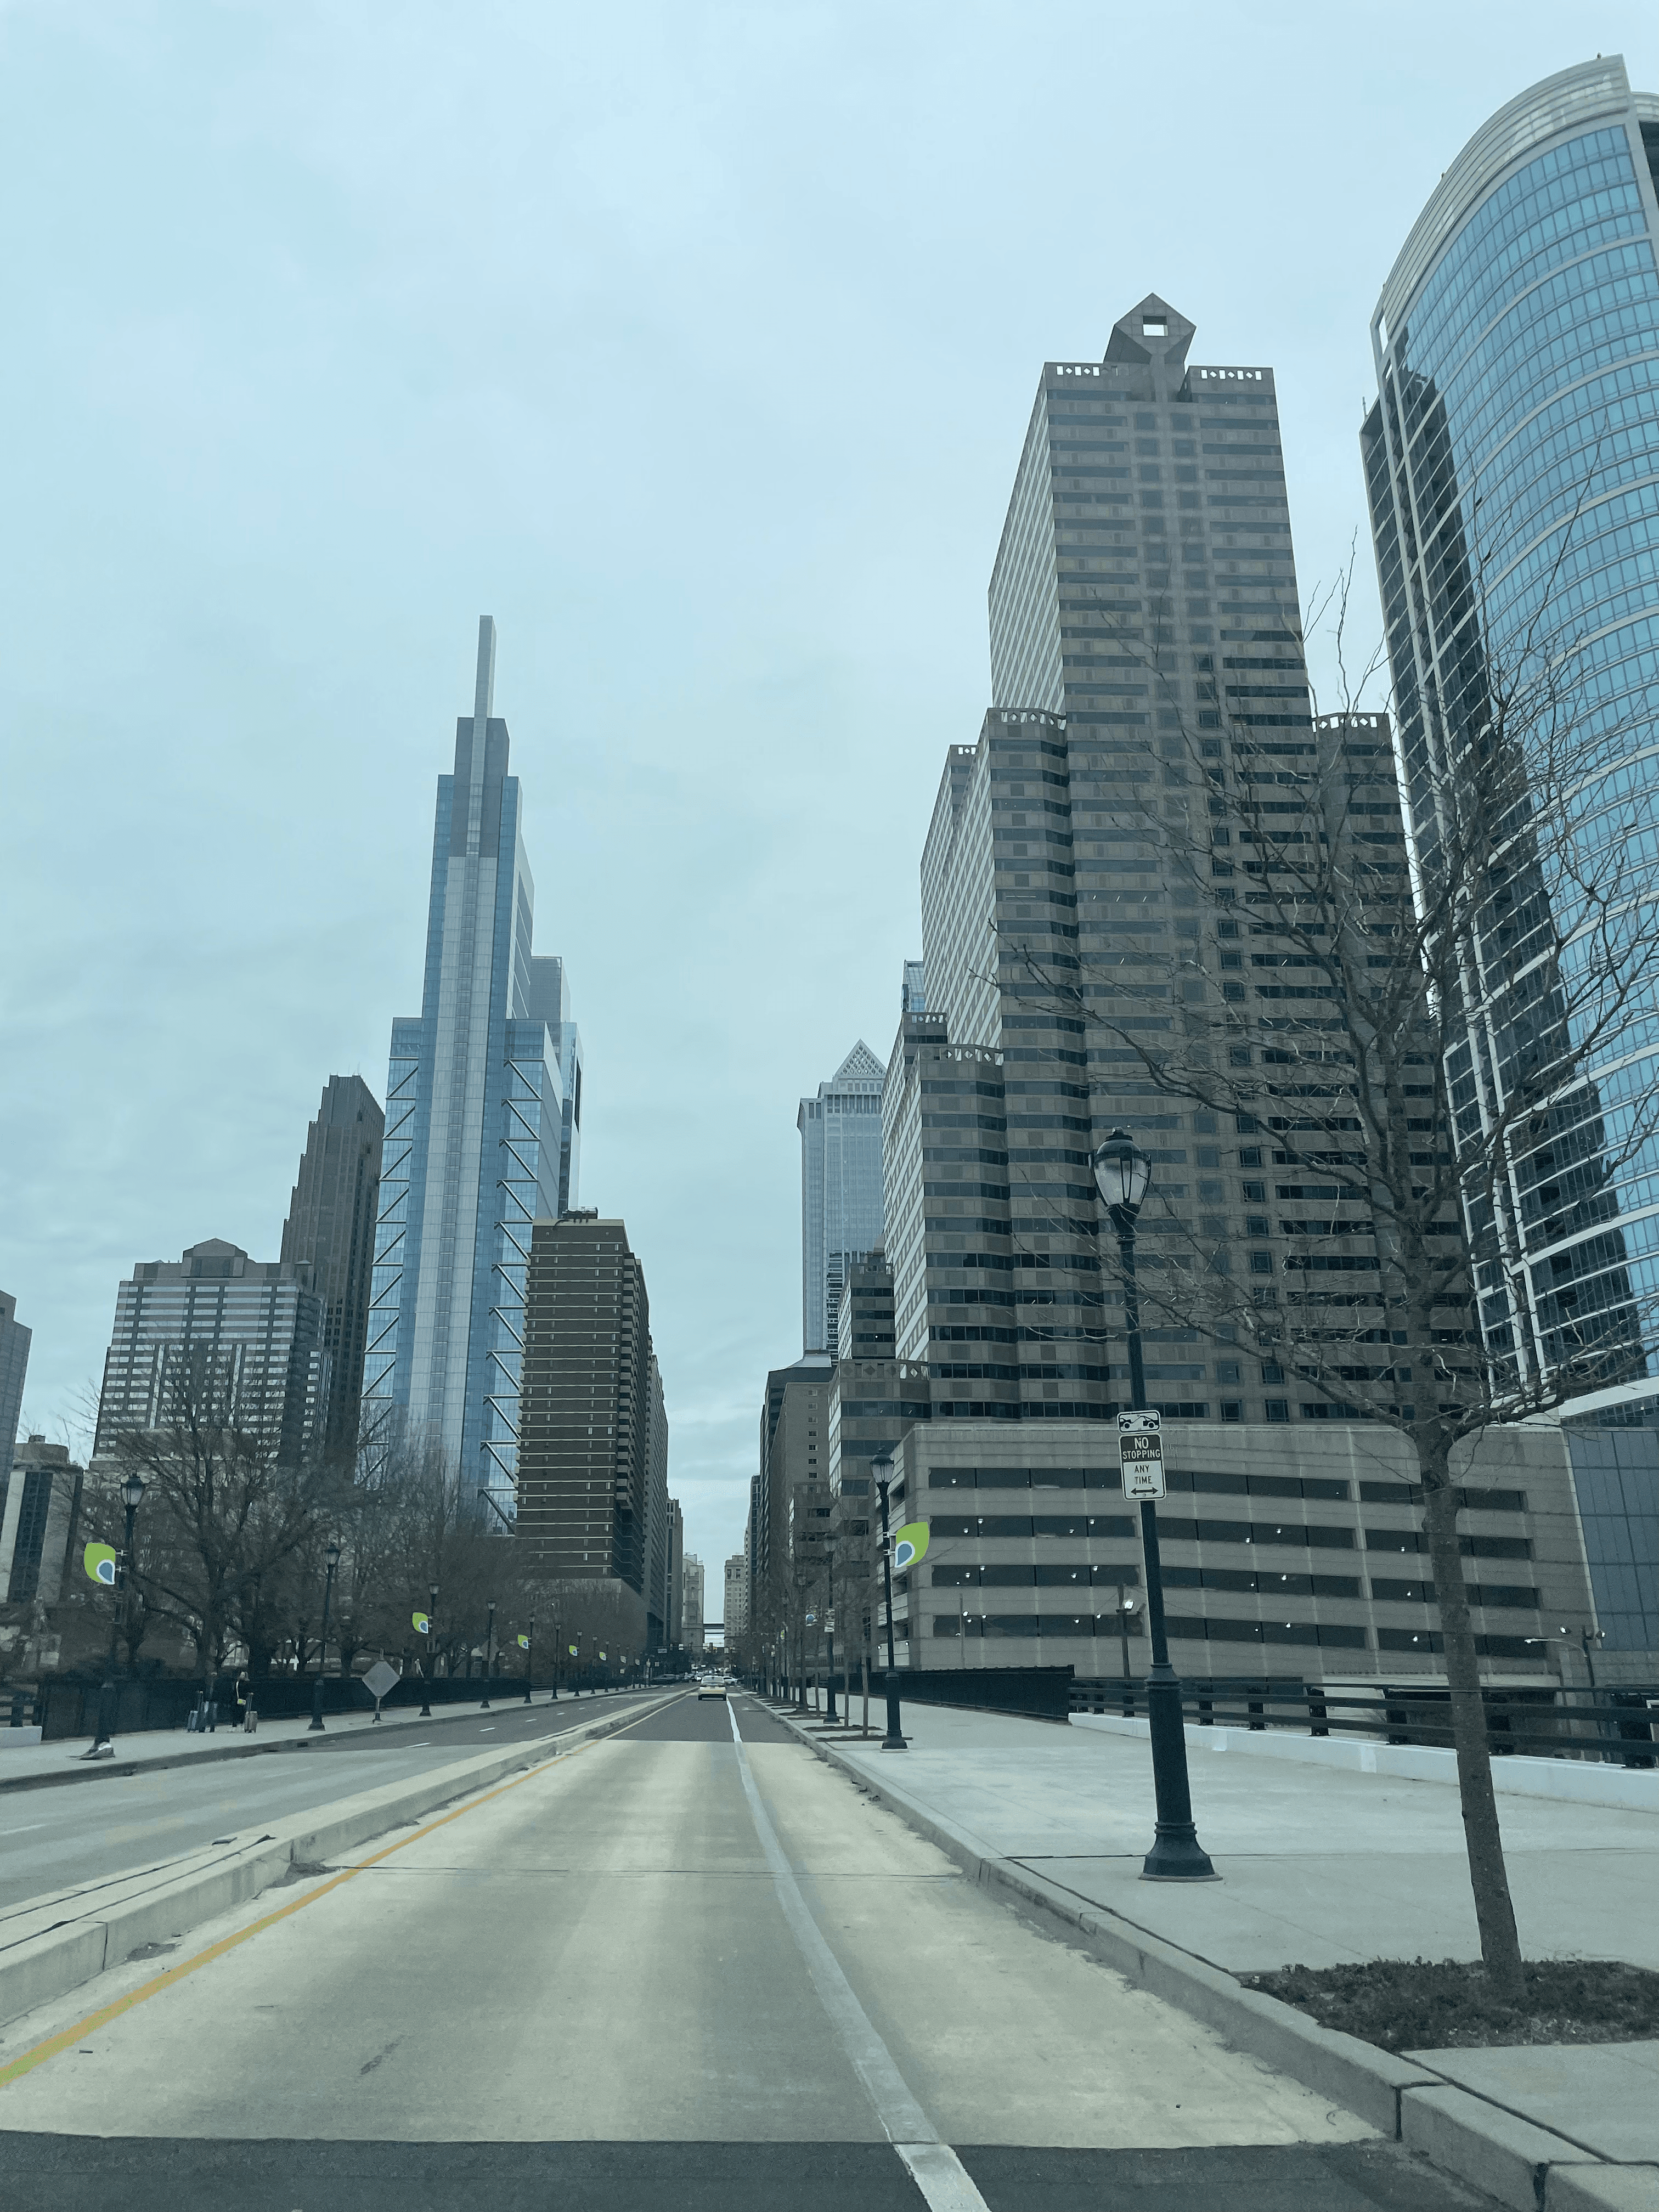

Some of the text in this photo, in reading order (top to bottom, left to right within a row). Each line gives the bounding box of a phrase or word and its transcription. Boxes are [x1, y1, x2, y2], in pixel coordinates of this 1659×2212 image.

[1134, 1437, 1149, 1449] NO
[1122, 1449, 1160, 1459] STOPPING
[1135, 1476, 1152, 1484] TIME
